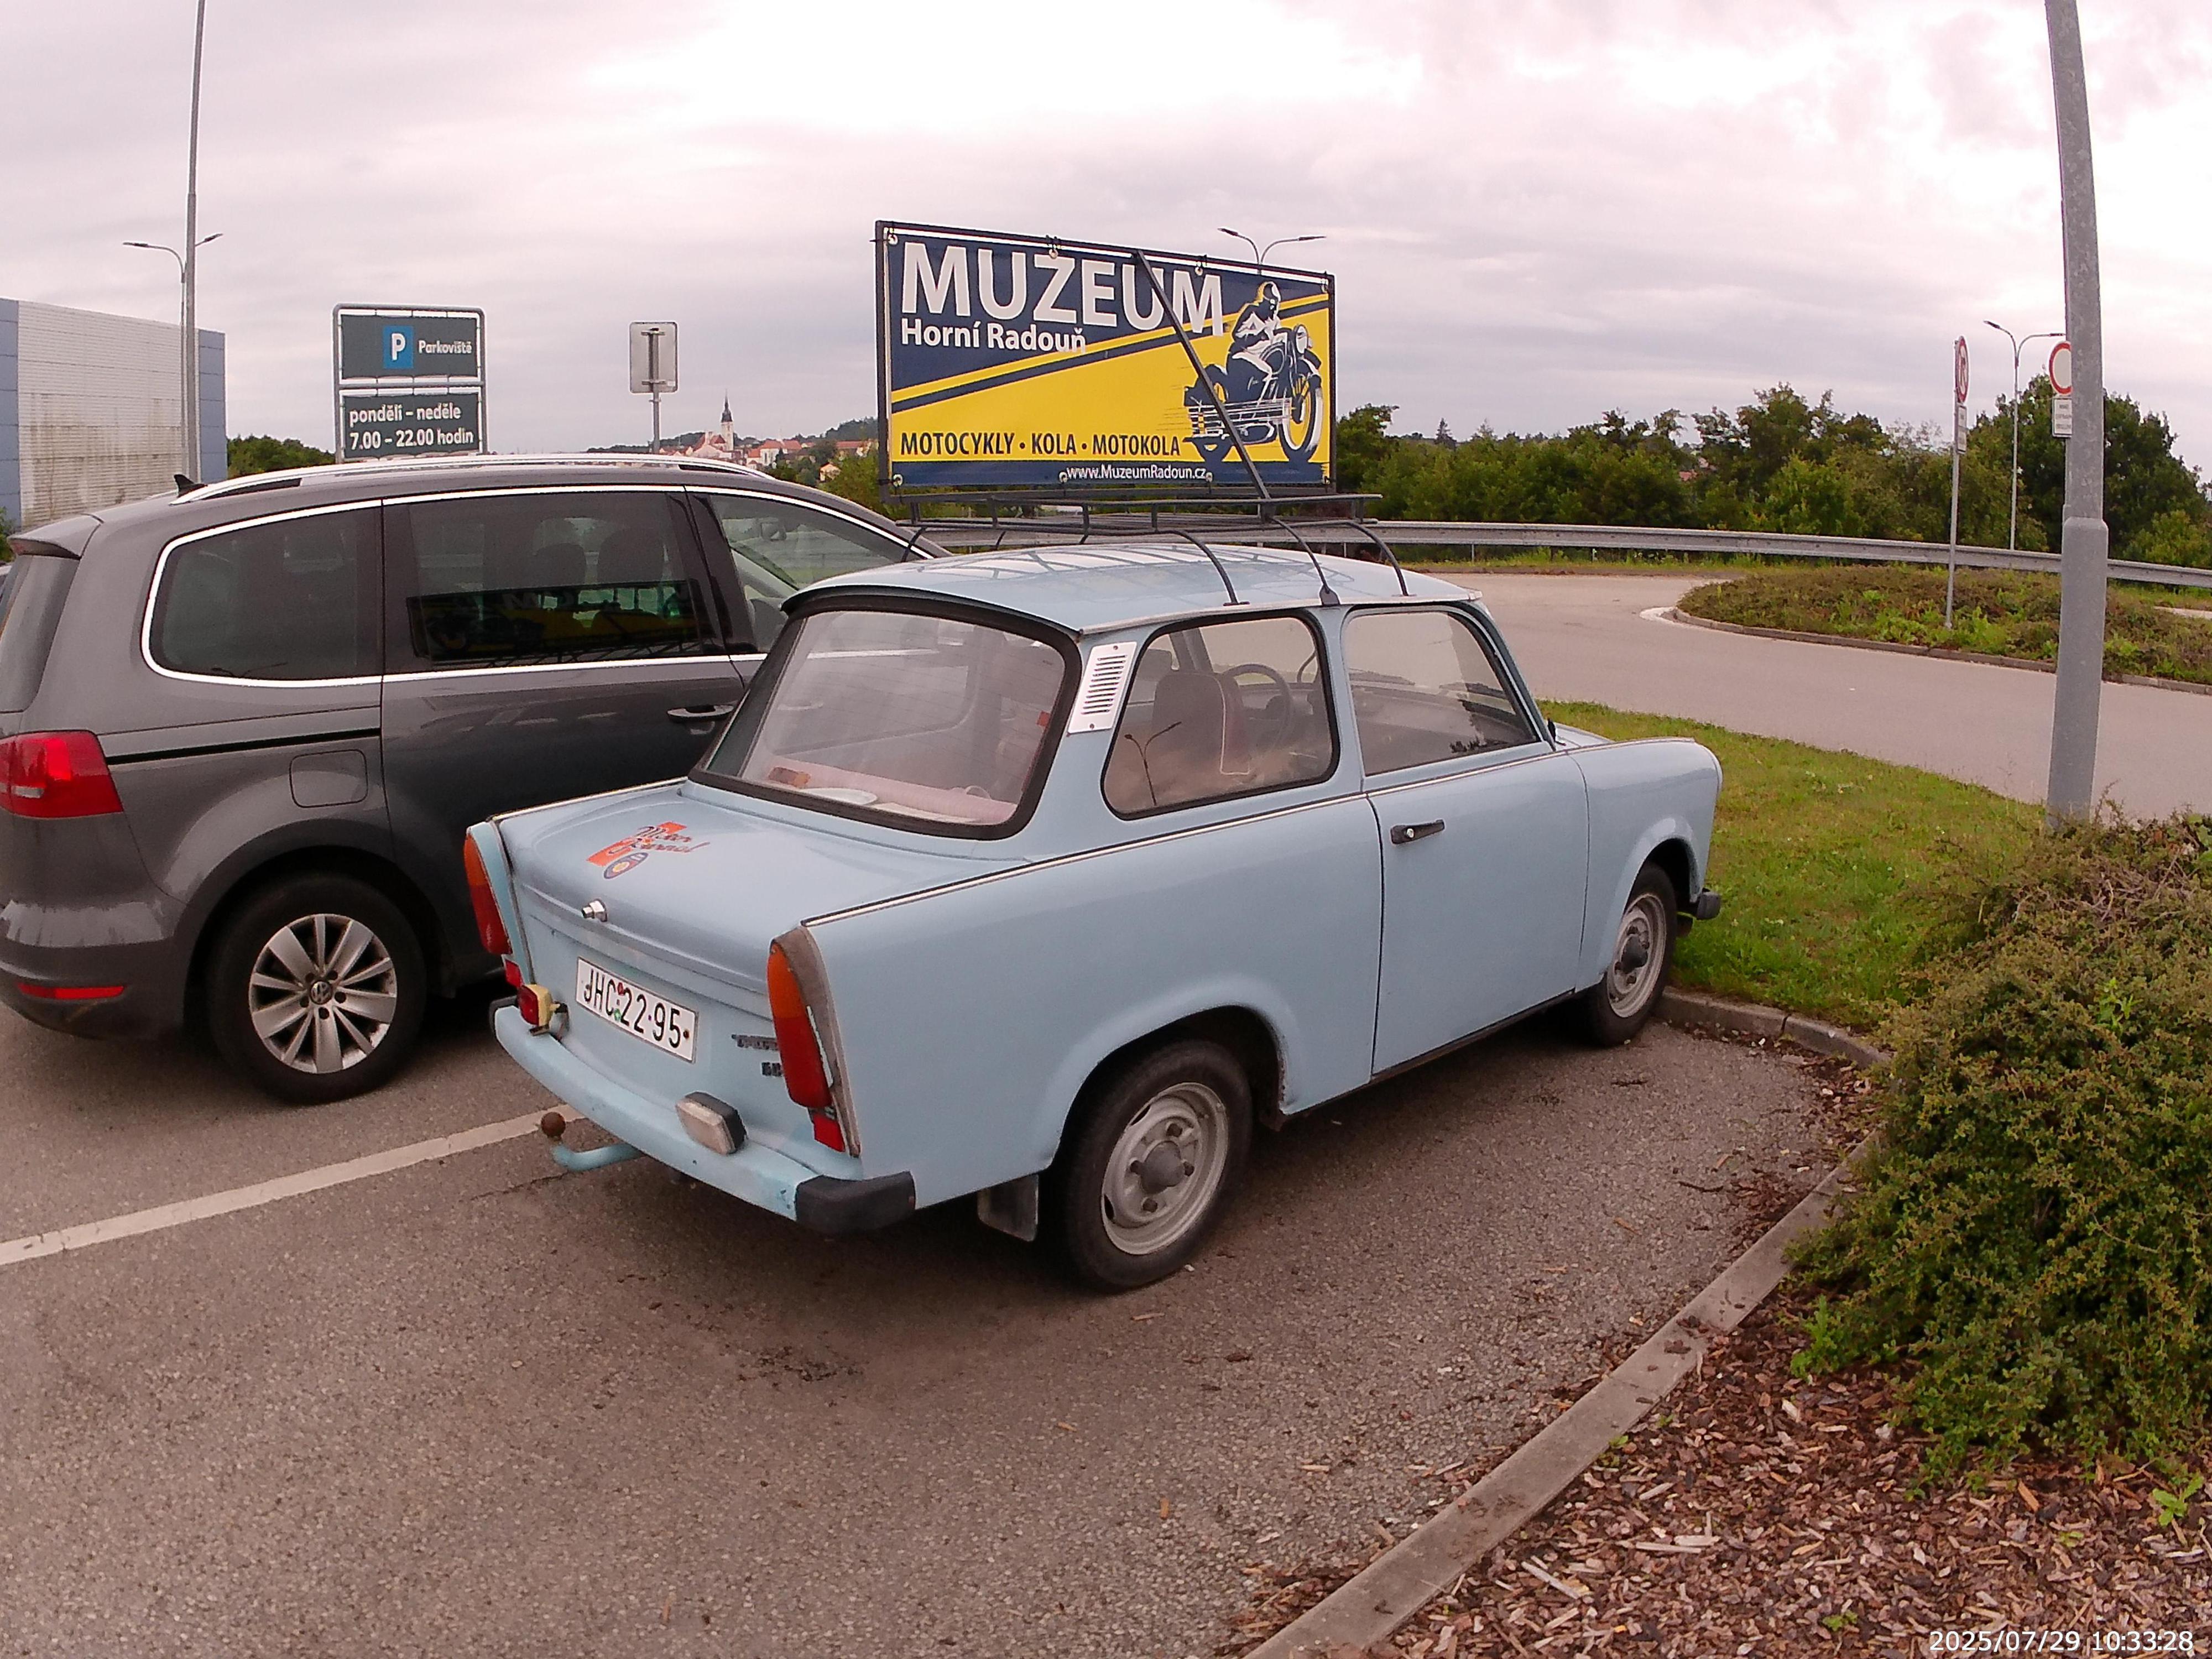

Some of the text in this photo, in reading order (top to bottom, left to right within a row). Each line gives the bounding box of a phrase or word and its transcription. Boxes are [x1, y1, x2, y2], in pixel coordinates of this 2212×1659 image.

[902, 242, 1223, 337] MUZEUM
[418, 340, 472, 354] Parkoviště
[901, 318, 1086, 354] Horní Radouň
[349, 404, 403, 427] pondělí
[416, 402, 461, 420] neděle
[349, 430, 381, 450] 7.00
[395, 428, 434, 447] 22.00
[436, 427, 474, 445] hodin
[901, 432, 1181, 456] MOTOCYKLY KOLA MOTOKOLA
[1067, 464, 1207, 480] www.MuzeumRadoun.cz
